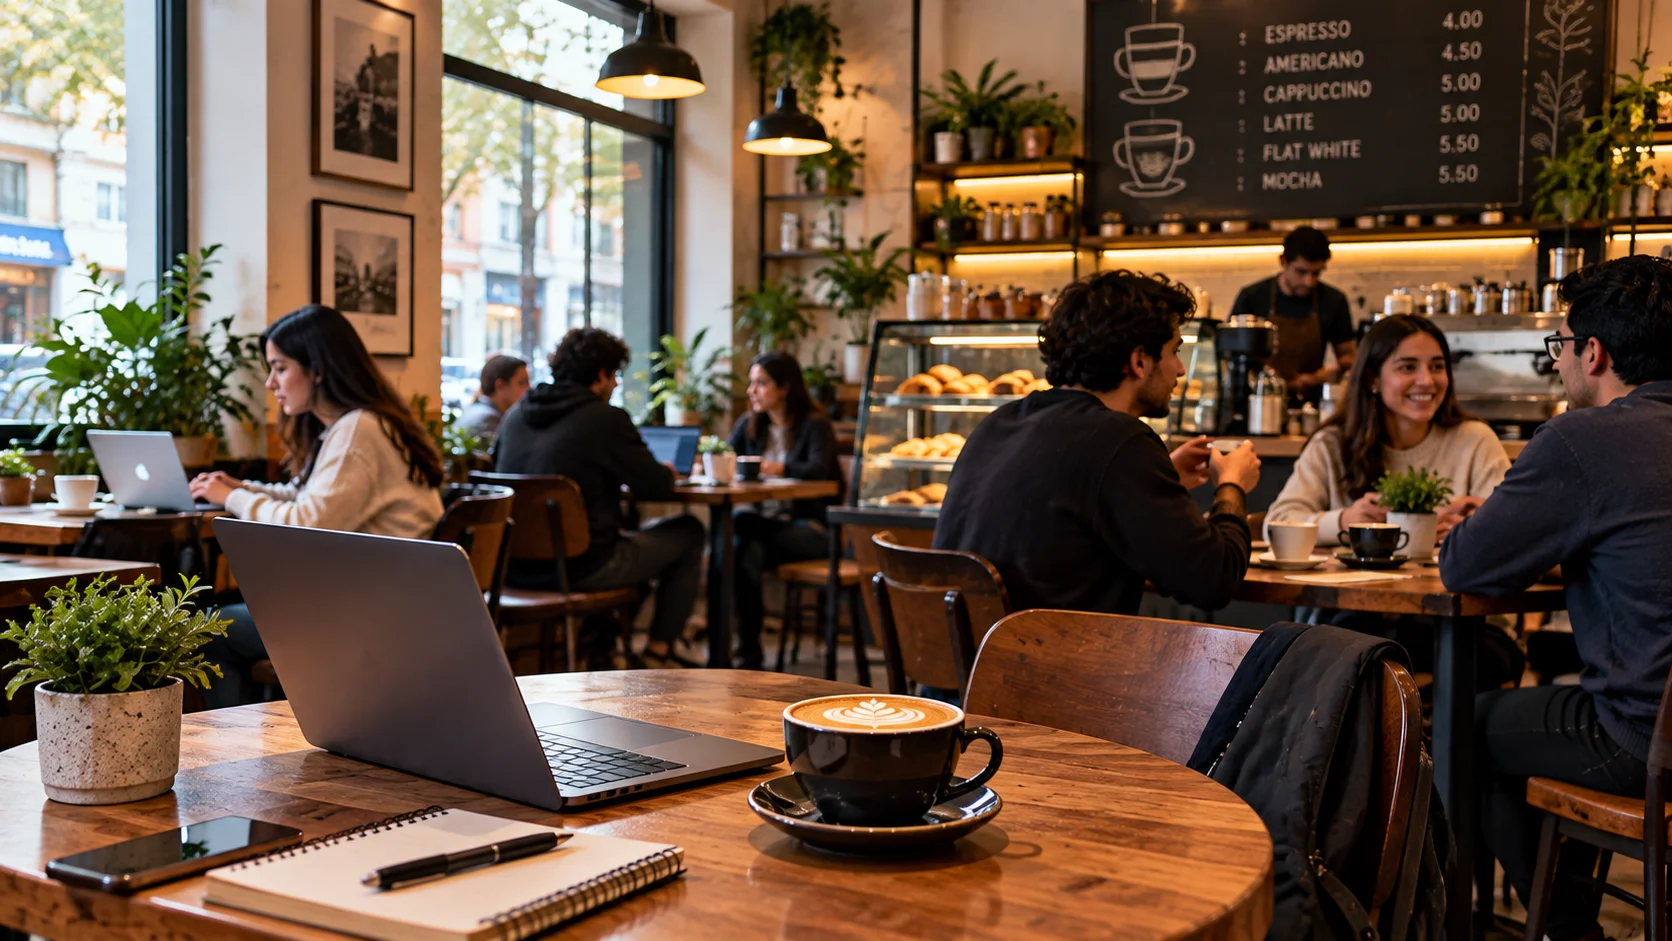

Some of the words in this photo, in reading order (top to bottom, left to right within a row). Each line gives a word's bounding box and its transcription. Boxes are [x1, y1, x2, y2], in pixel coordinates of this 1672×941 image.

[1265, 20, 1351, 44] ESPRESSO
[1442, 10, 1483, 30] 4.00
[1264, 50, 1364, 74] AMERICANO
[1441, 41, 1482, 62] 4.50
[1263, 80, 1372, 104] CAPPUCCINO
[1441, 72, 1481, 93] 5.00
[1263, 112, 1314, 133] LATTE
[1440, 103, 1480, 123] 5.00
[1262, 142, 1303, 162] FLAT
[1308, 139, 1361, 159] WHITE
[1440, 133, 1479, 153] 5.50
[1262, 171, 1322, 190] MOCHA
[1439, 164, 1478, 184] 5.50
